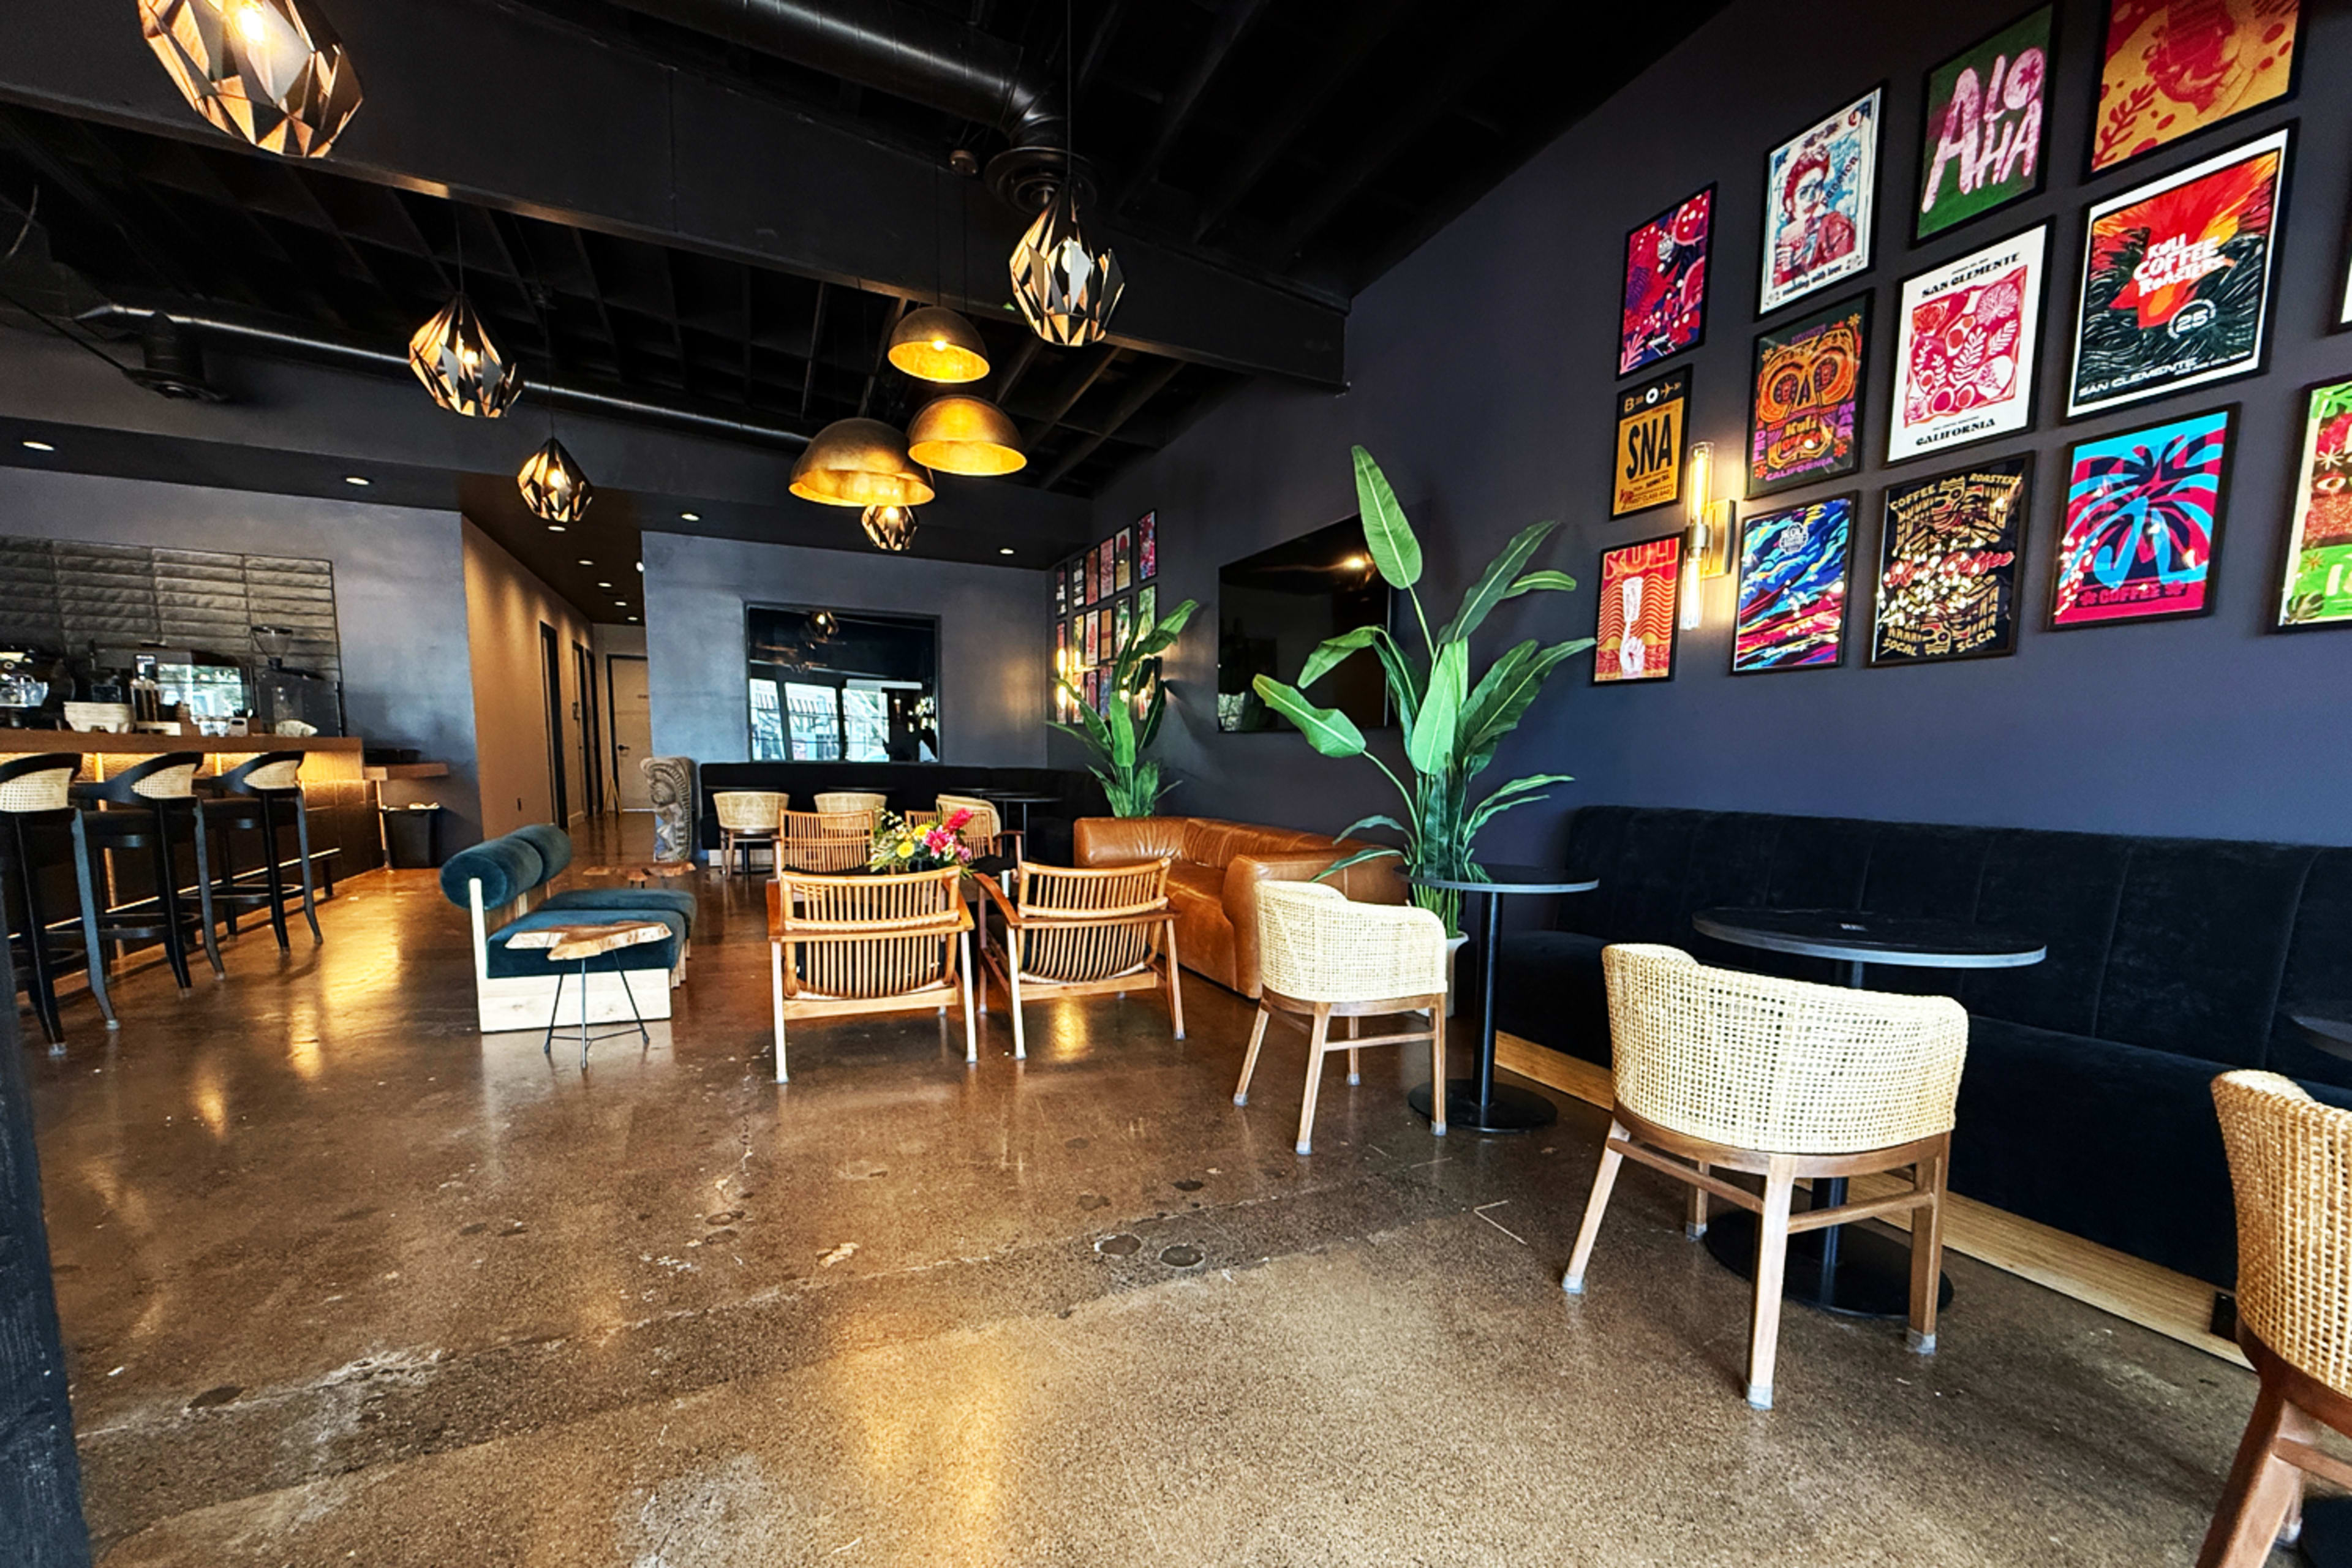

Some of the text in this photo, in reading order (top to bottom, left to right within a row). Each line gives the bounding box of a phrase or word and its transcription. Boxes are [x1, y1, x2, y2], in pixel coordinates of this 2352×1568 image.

[1921, 47, 2045, 213] ALOHA
[1921, 281, 1948, 298] SAN
[1951, 252, 2021, 287] CLEMENTE
[2133, 236, 2220, 281] COFFEE
[2138, 254, 2226, 297] ROASTERS
[2176, 308, 2209, 333] 25
[2079, 382, 2109, 397] SAN
[2112, 356, 2198, 388] CLEMENTE
[1626, 413, 1673, 480] SNA
[1915, 418, 1996, 446] CALIFORNIA
[1765, 457, 1834, 482] CALIFORNIA
[1888, 484, 1937, 511] COFFEE
[1603, 537, 1680, 581] KULI
[2098, 582, 2161, 605] COFFEE
